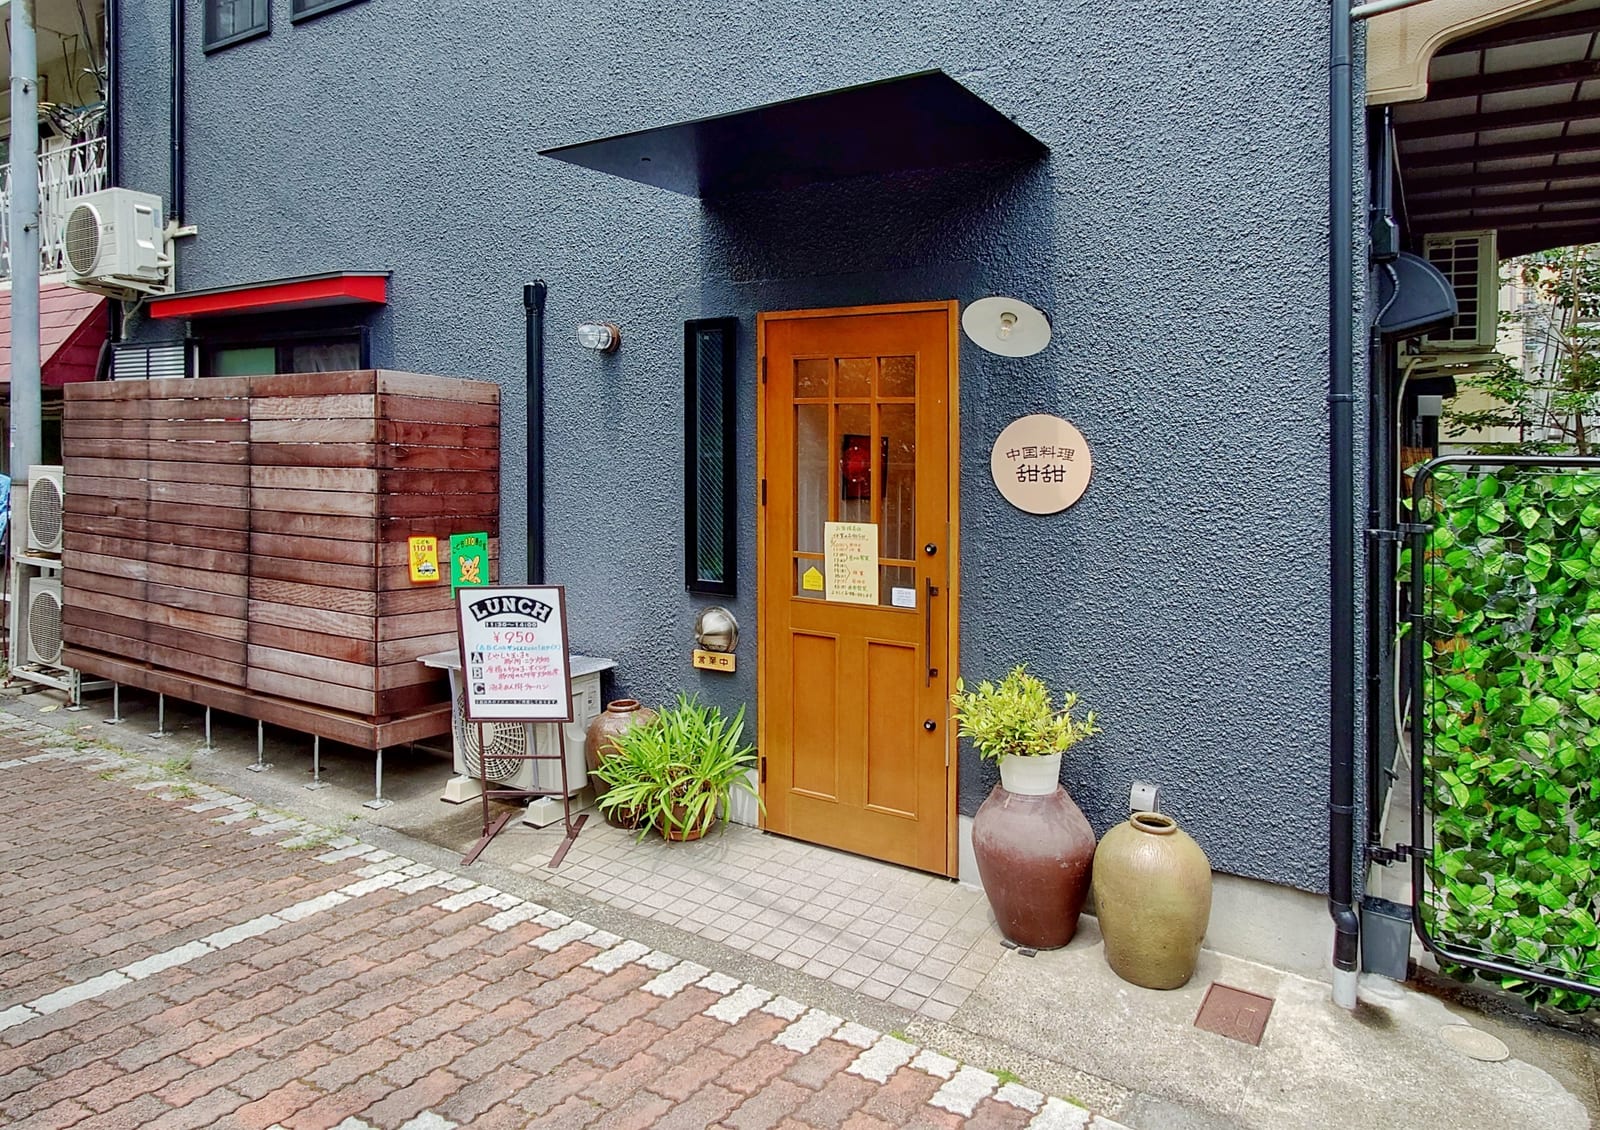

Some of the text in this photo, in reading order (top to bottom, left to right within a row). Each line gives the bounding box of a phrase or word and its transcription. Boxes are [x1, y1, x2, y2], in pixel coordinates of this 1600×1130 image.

[1006, 445, 1076, 462] 中国料理
[1016, 464, 1066, 483] 甜甜
[470, 597, 551, 621] LUNCH
[471, 652, 484, 664] A
[472, 667, 483, 679] B
[473, 682, 486, 695] C
